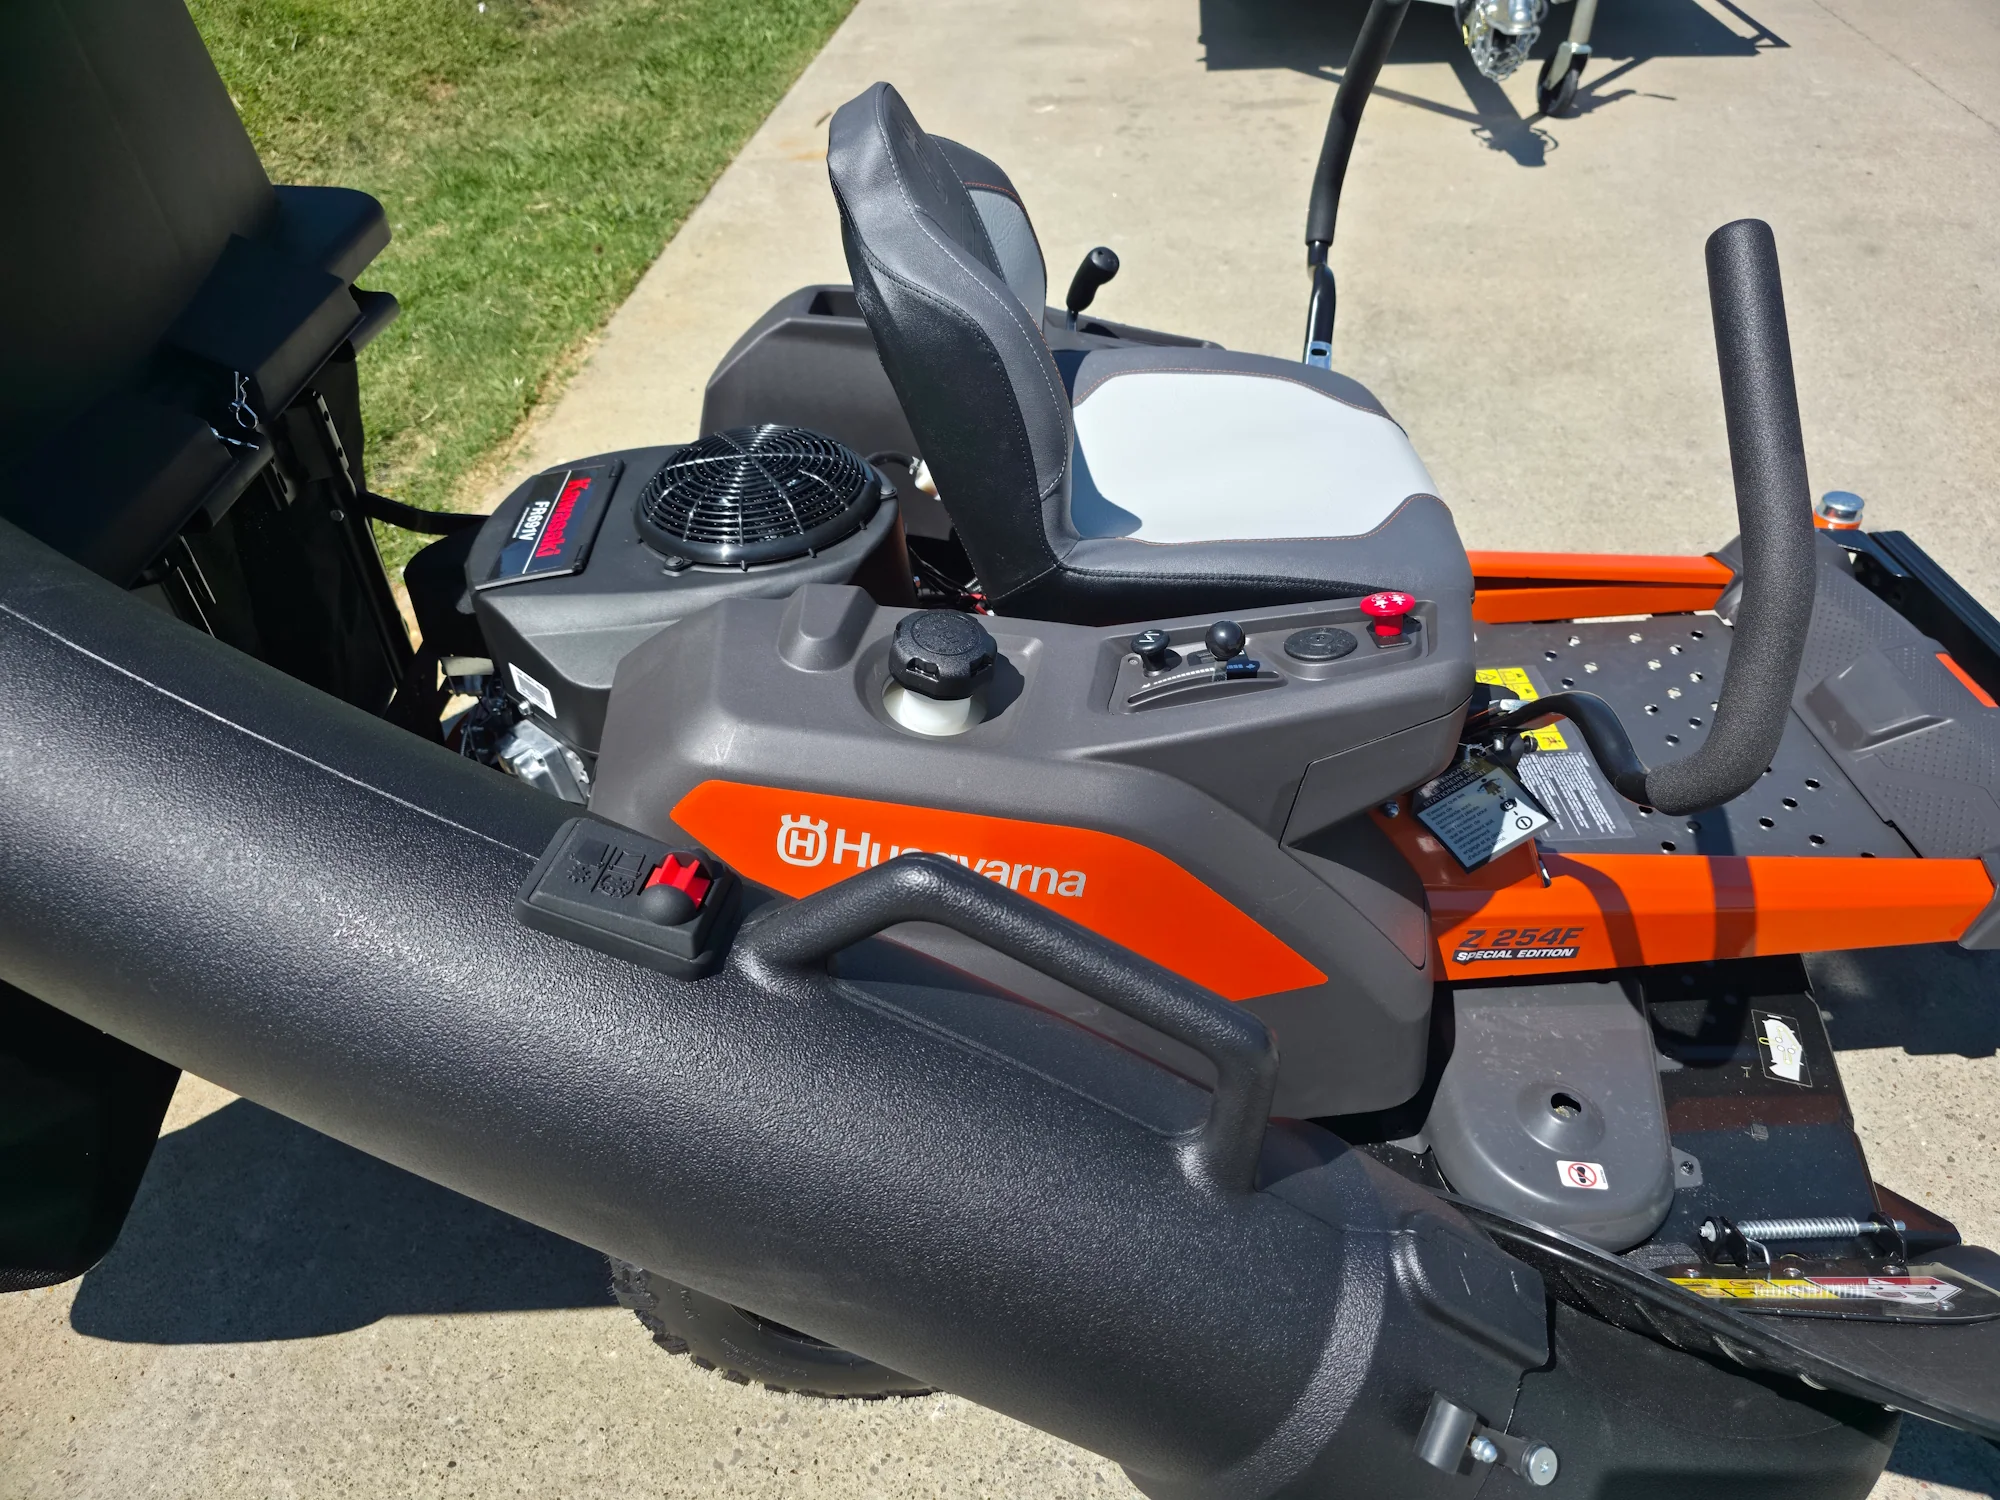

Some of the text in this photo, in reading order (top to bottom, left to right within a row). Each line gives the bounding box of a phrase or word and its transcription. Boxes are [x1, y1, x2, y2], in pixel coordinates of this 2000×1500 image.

[518, 501, 551, 540] FR691V
[536, 478, 591, 557] Kawasaki
[1422, 767, 1487, 808] STATIONNEMENT
[832, 827, 1088, 898] Huvarna
[1456, 948, 1575, 961] SPECIAL EDITION
[1458, 927, 1584, 948] Z 254F
